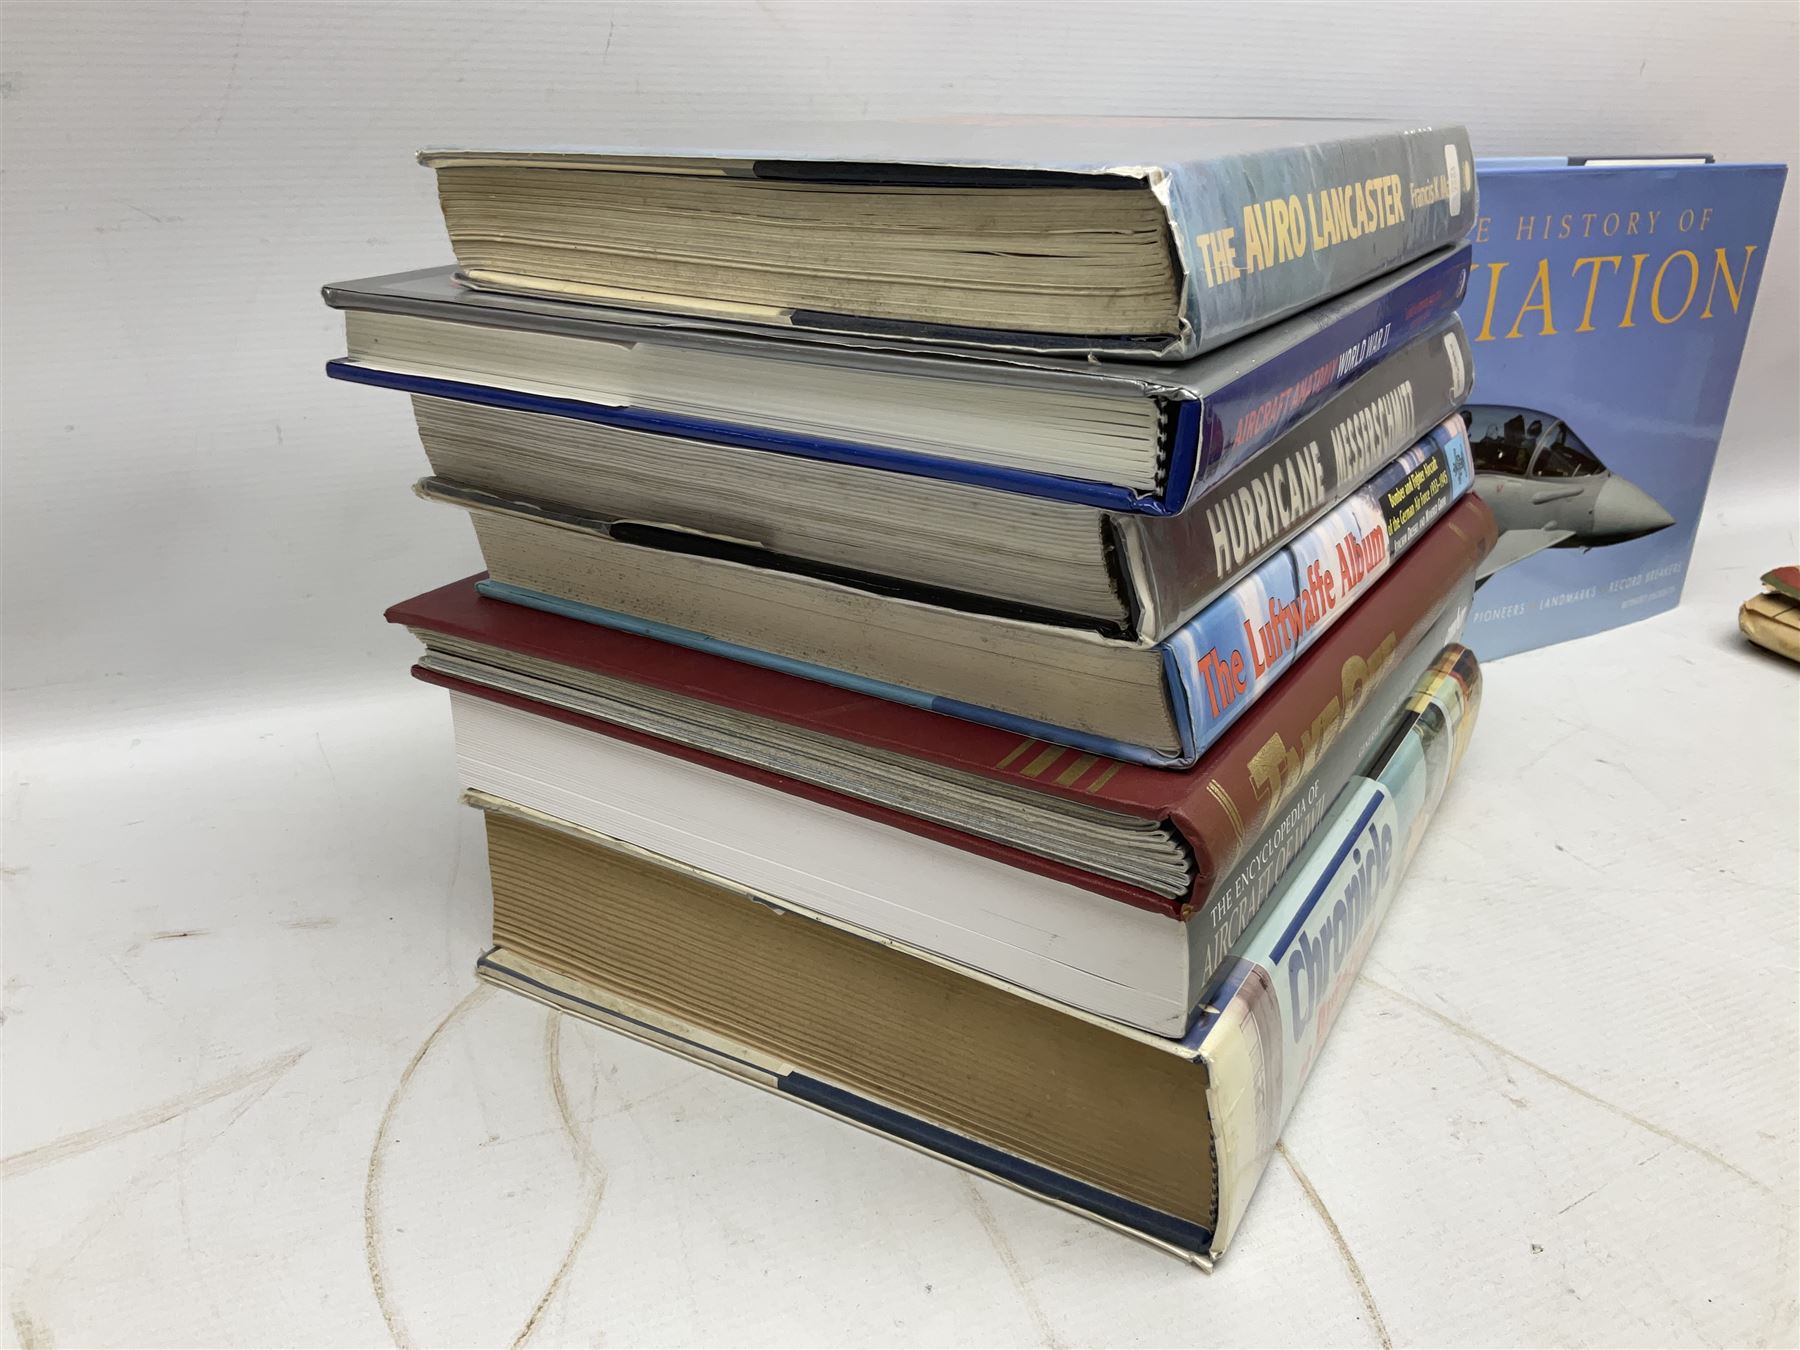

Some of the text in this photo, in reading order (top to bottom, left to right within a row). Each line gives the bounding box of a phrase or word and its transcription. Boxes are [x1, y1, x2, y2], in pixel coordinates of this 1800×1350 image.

[1196, 174, 1405, 288] THE AVRO LANCASTER
[1516, 211, 1661, 240] HISTORY
[1679, 208, 1712, 232] OF
[1470, 245, 1757, 341] IATION
[1233, 387, 1294, 449] AIRCRAFT
[1337, 339, 1367, 379] WORLD
[1365, 327, 1384, 360] WAR
[1382, 323, 1391, 348] II
[1206, 380, 1415, 578] HURRICANE MESSERSCHMITT
[1197, 525, 1386, 719] The Luftwaffe Album
[1473, 603, 1525, 623] PIONEERS
[1540, 586, 1597, 611] LANDMARKS
[1608, 574, 1642, 592] RECORD
[1210, 779, 1320, 929] THE ENCYCLOPEDIA OF
[1201, 861, 1274, 986] AIRCRAFT
[1288, 822, 1392, 1044] Chronicle
